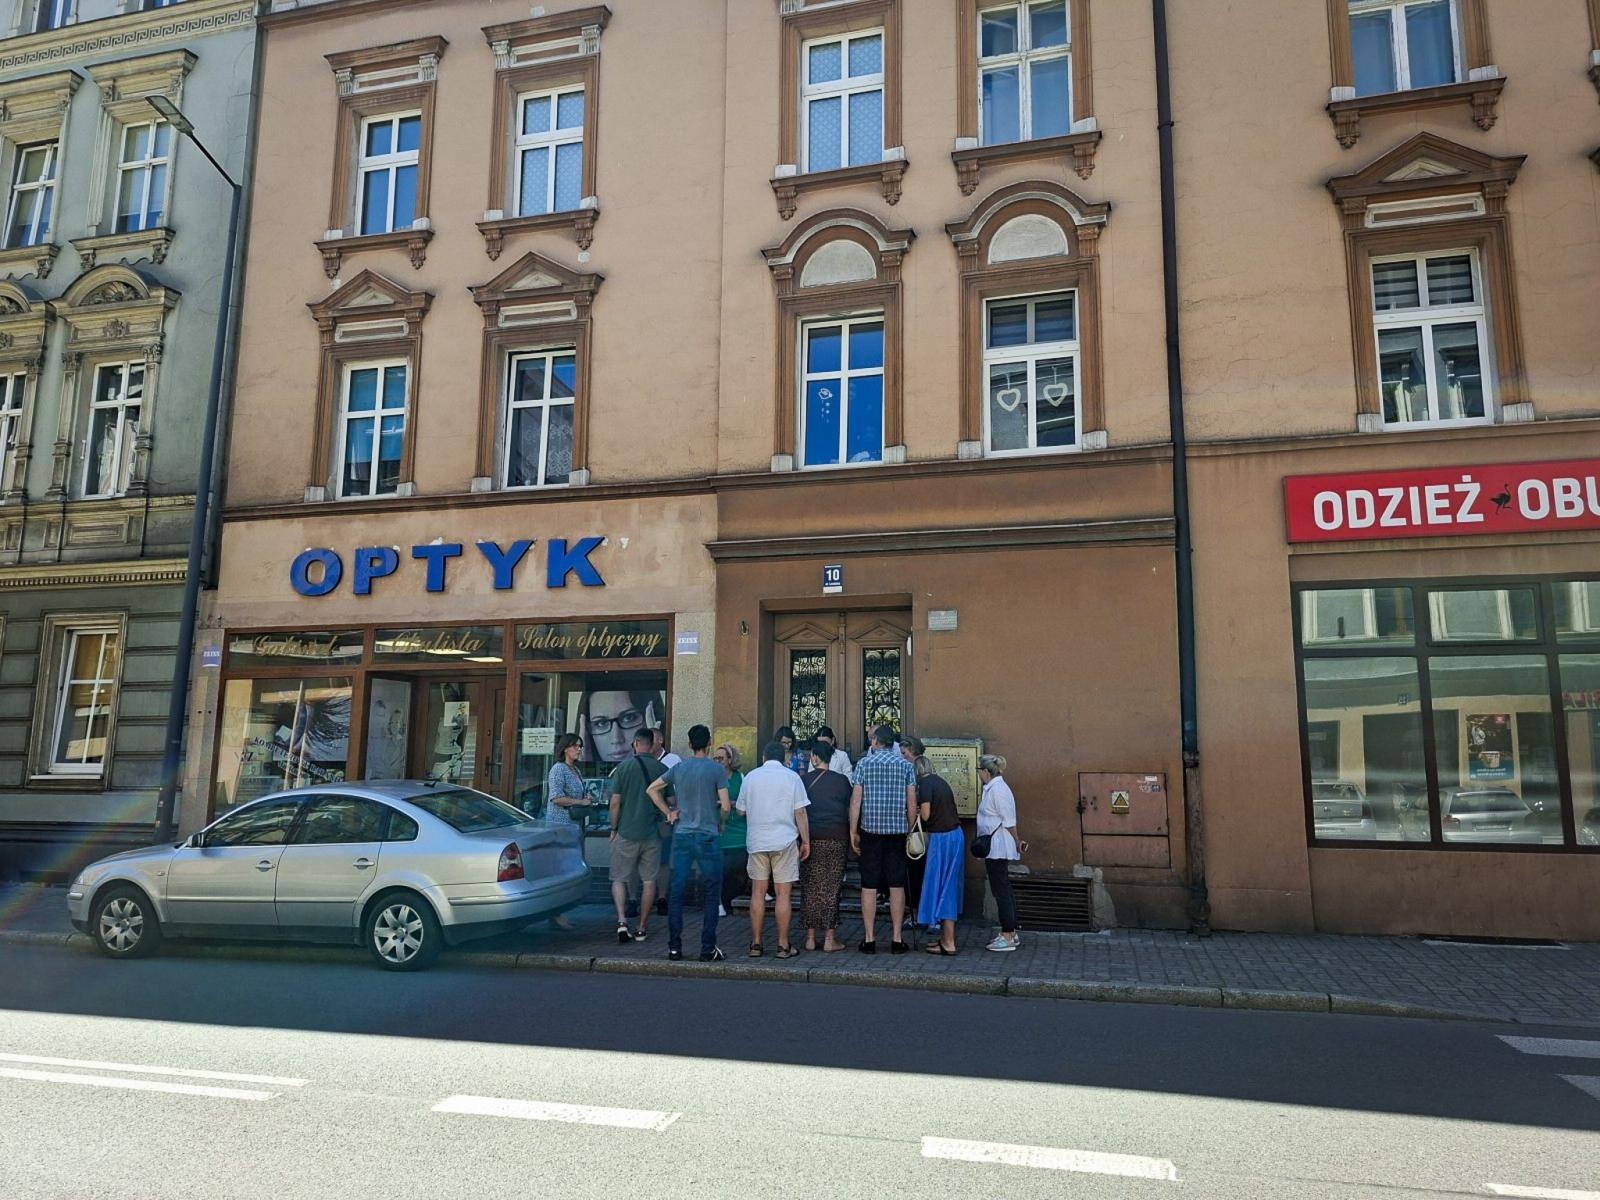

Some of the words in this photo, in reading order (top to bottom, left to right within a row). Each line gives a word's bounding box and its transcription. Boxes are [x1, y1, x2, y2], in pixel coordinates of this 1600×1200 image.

[1313, 475, 1484, 531] ODZIEŻ
[289, 536, 606, 597] OPTYK
[825, 568, 840, 581] 10
[519, 626, 574, 649] Salon
[576, 626, 662, 657] optyczny
